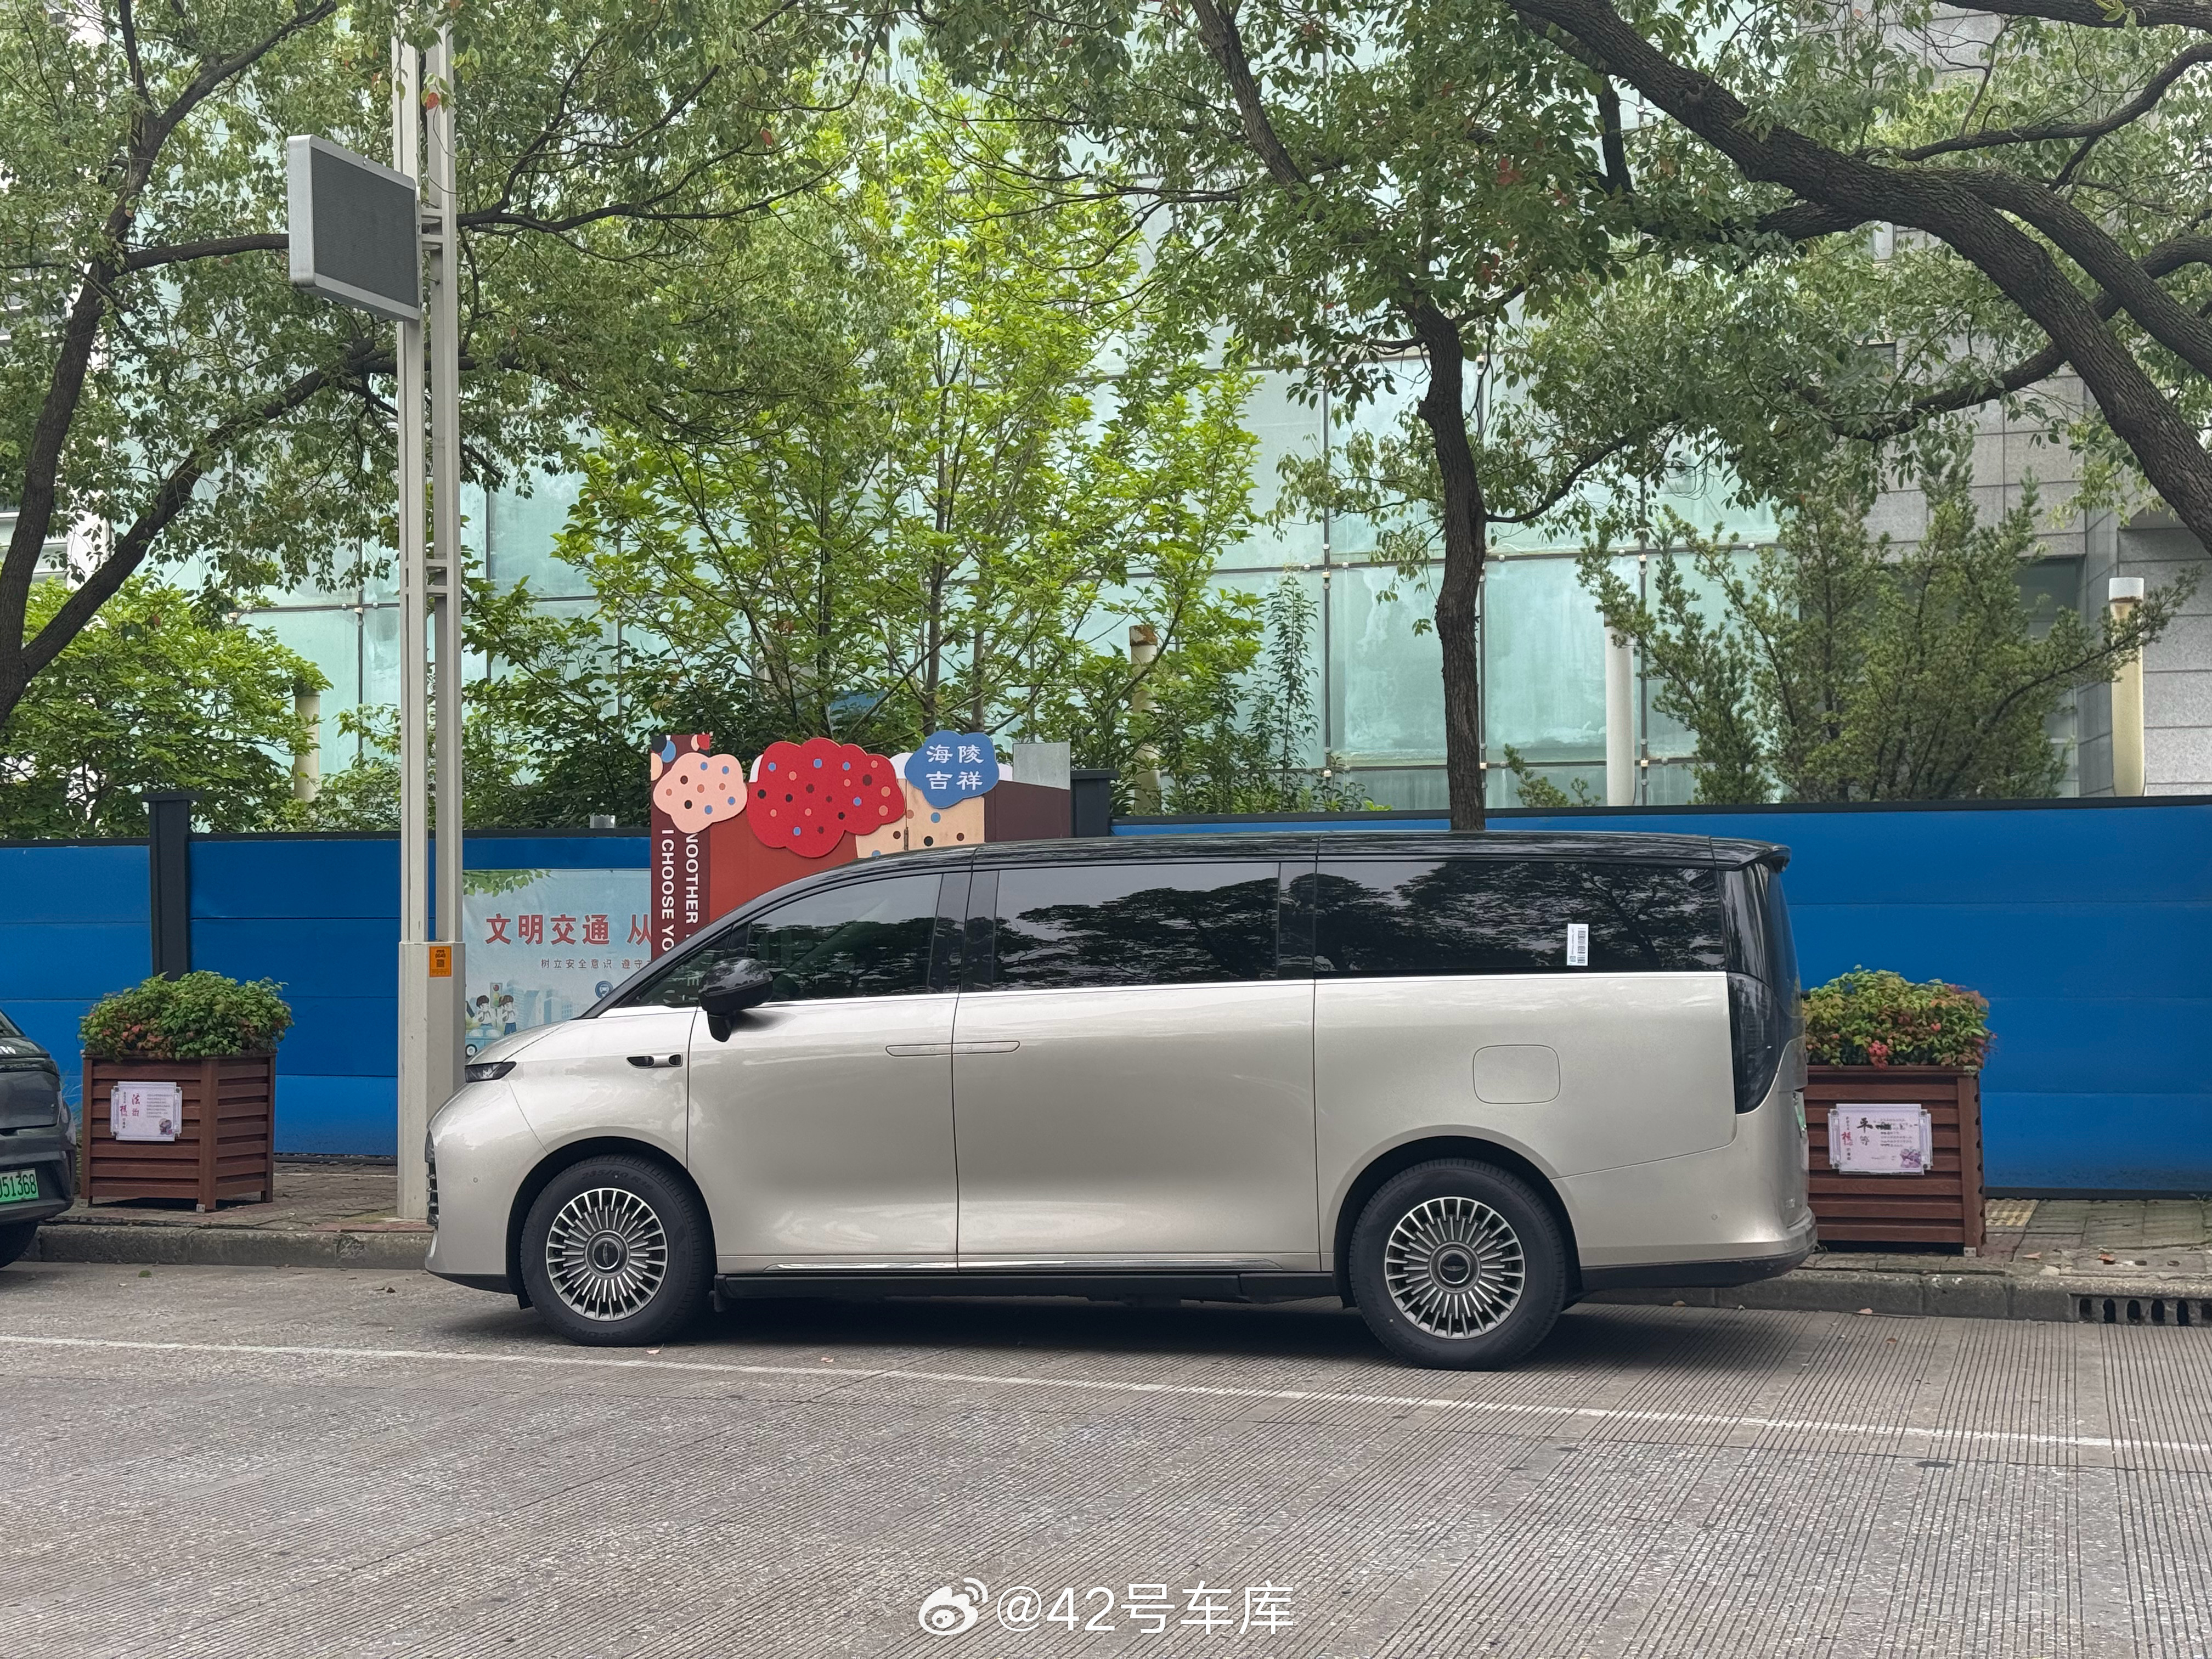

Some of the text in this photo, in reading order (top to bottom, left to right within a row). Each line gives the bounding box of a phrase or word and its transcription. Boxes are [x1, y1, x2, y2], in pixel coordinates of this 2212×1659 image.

[926, 744, 984, 764] 海陵
[926, 771, 983, 791] 吉祥
[662, 839, 674, 920] CHOOSE
[485, 913, 610, 946] 文明交通
[541, 958, 612, 969] 树立安全意识
